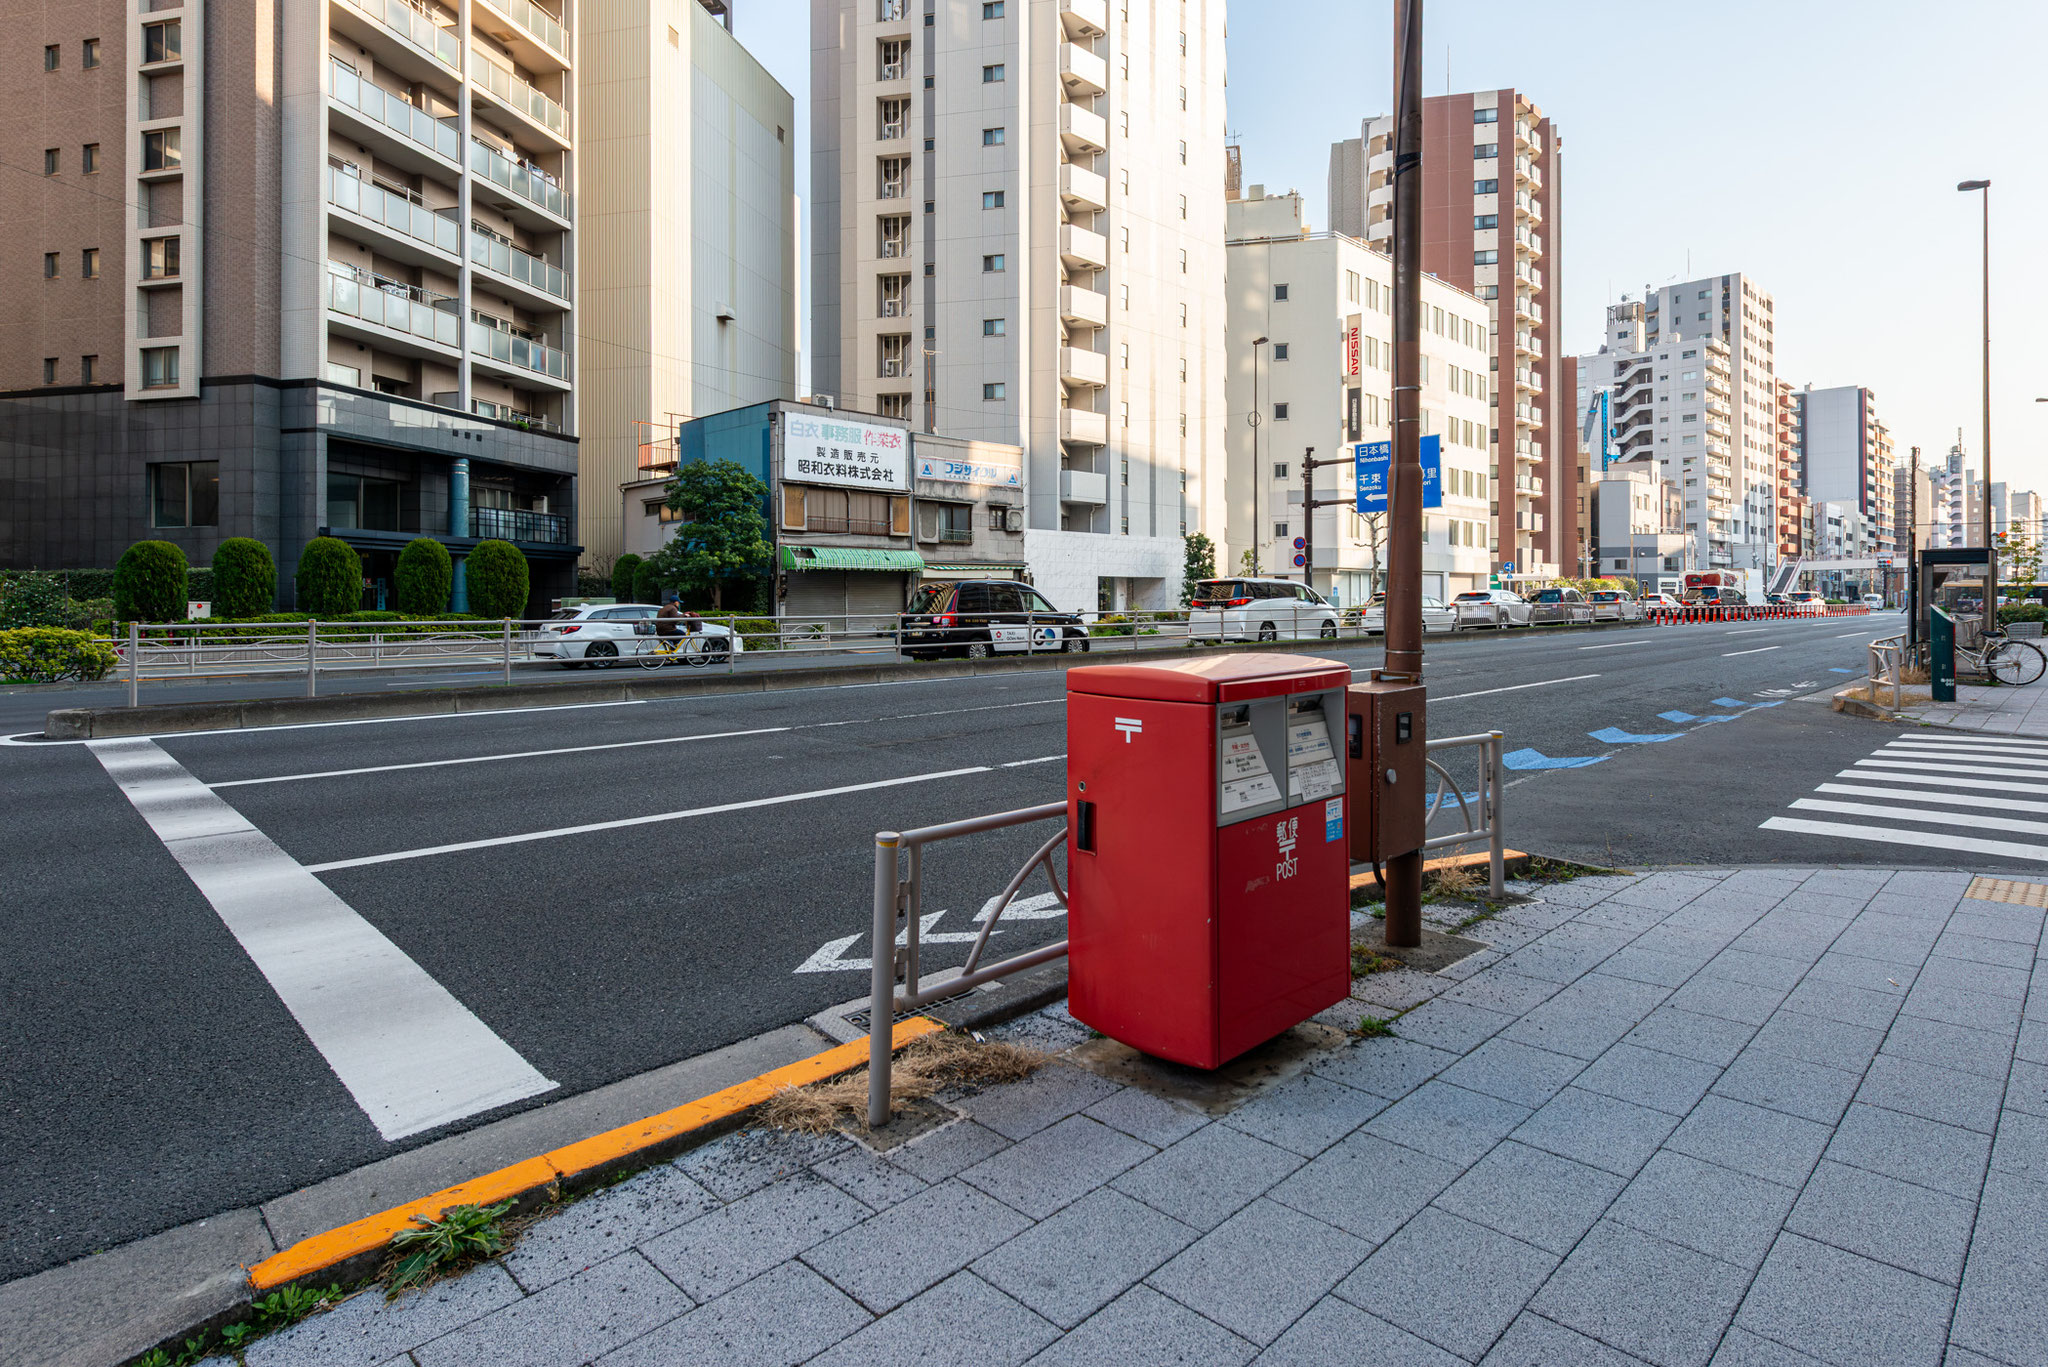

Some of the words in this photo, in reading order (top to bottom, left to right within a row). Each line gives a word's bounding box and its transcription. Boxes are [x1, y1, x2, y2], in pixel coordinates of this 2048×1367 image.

[1350, 327, 1359, 376] NISSAN
[790, 419, 819, 439] 白衣
[821, 423, 862, 445] 事務服
[816, 446, 880, 464] 製造販売元
[1359, 443, 1389, 457] 日本橋
[1359, 455, 1389, 463] Nihonbashi
[797, 459, 894, 482] 昭和衣料株式会社
[945, 462, 998, 478] フジサイクル
[1359, 473, 1381, 485] 千束
[1359, 484, 1382, 492] Senzoku
[1276, 816, 1298, 843] 郵便
[1276, 857, 1298, 882] POST
